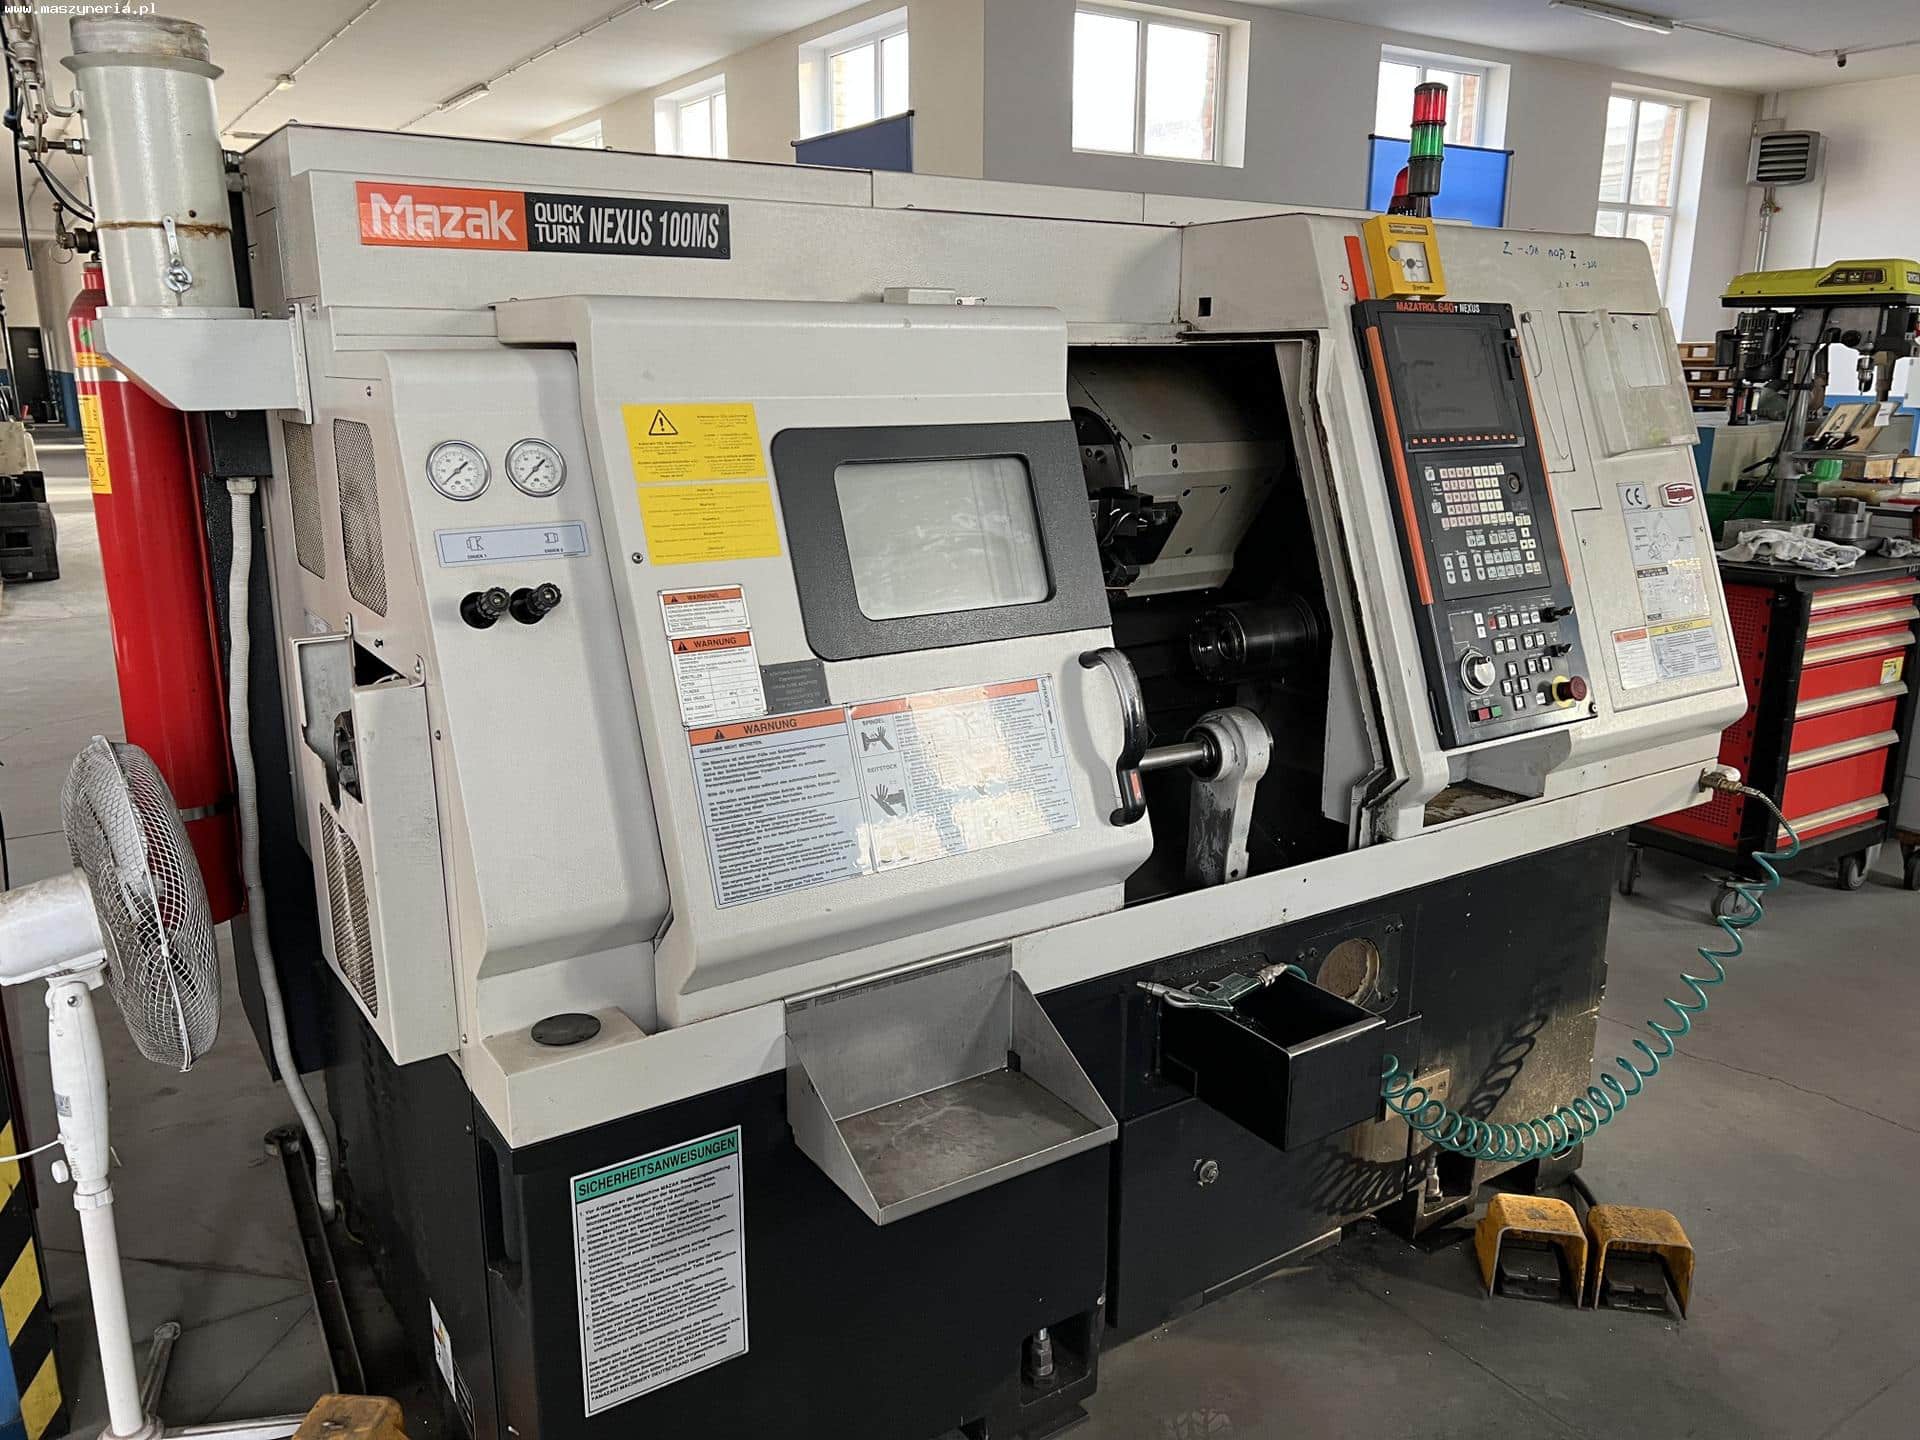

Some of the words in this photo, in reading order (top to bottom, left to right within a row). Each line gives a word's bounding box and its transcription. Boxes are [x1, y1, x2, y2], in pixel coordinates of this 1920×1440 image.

[370, 192, 518, 242] Mazak
[534, 202, 584, 224] QUICK
[535, 223, 581, 245] TURN
[589, 207, 653, 247] NEXUS
[660, 210, 720, 249] 100MS
[1338, 274, 1349, 292] 3
[1396, 302, 1437, 313] MAZATROL
[1459, 303, 1480, 314] NEXUS
[693, 637, 737, 649] WARNUNG
[743, 717, 798, 736] WARNUNG
[578, 1136, 735, 1196] SICHERHEITSANWEISUNGEN
